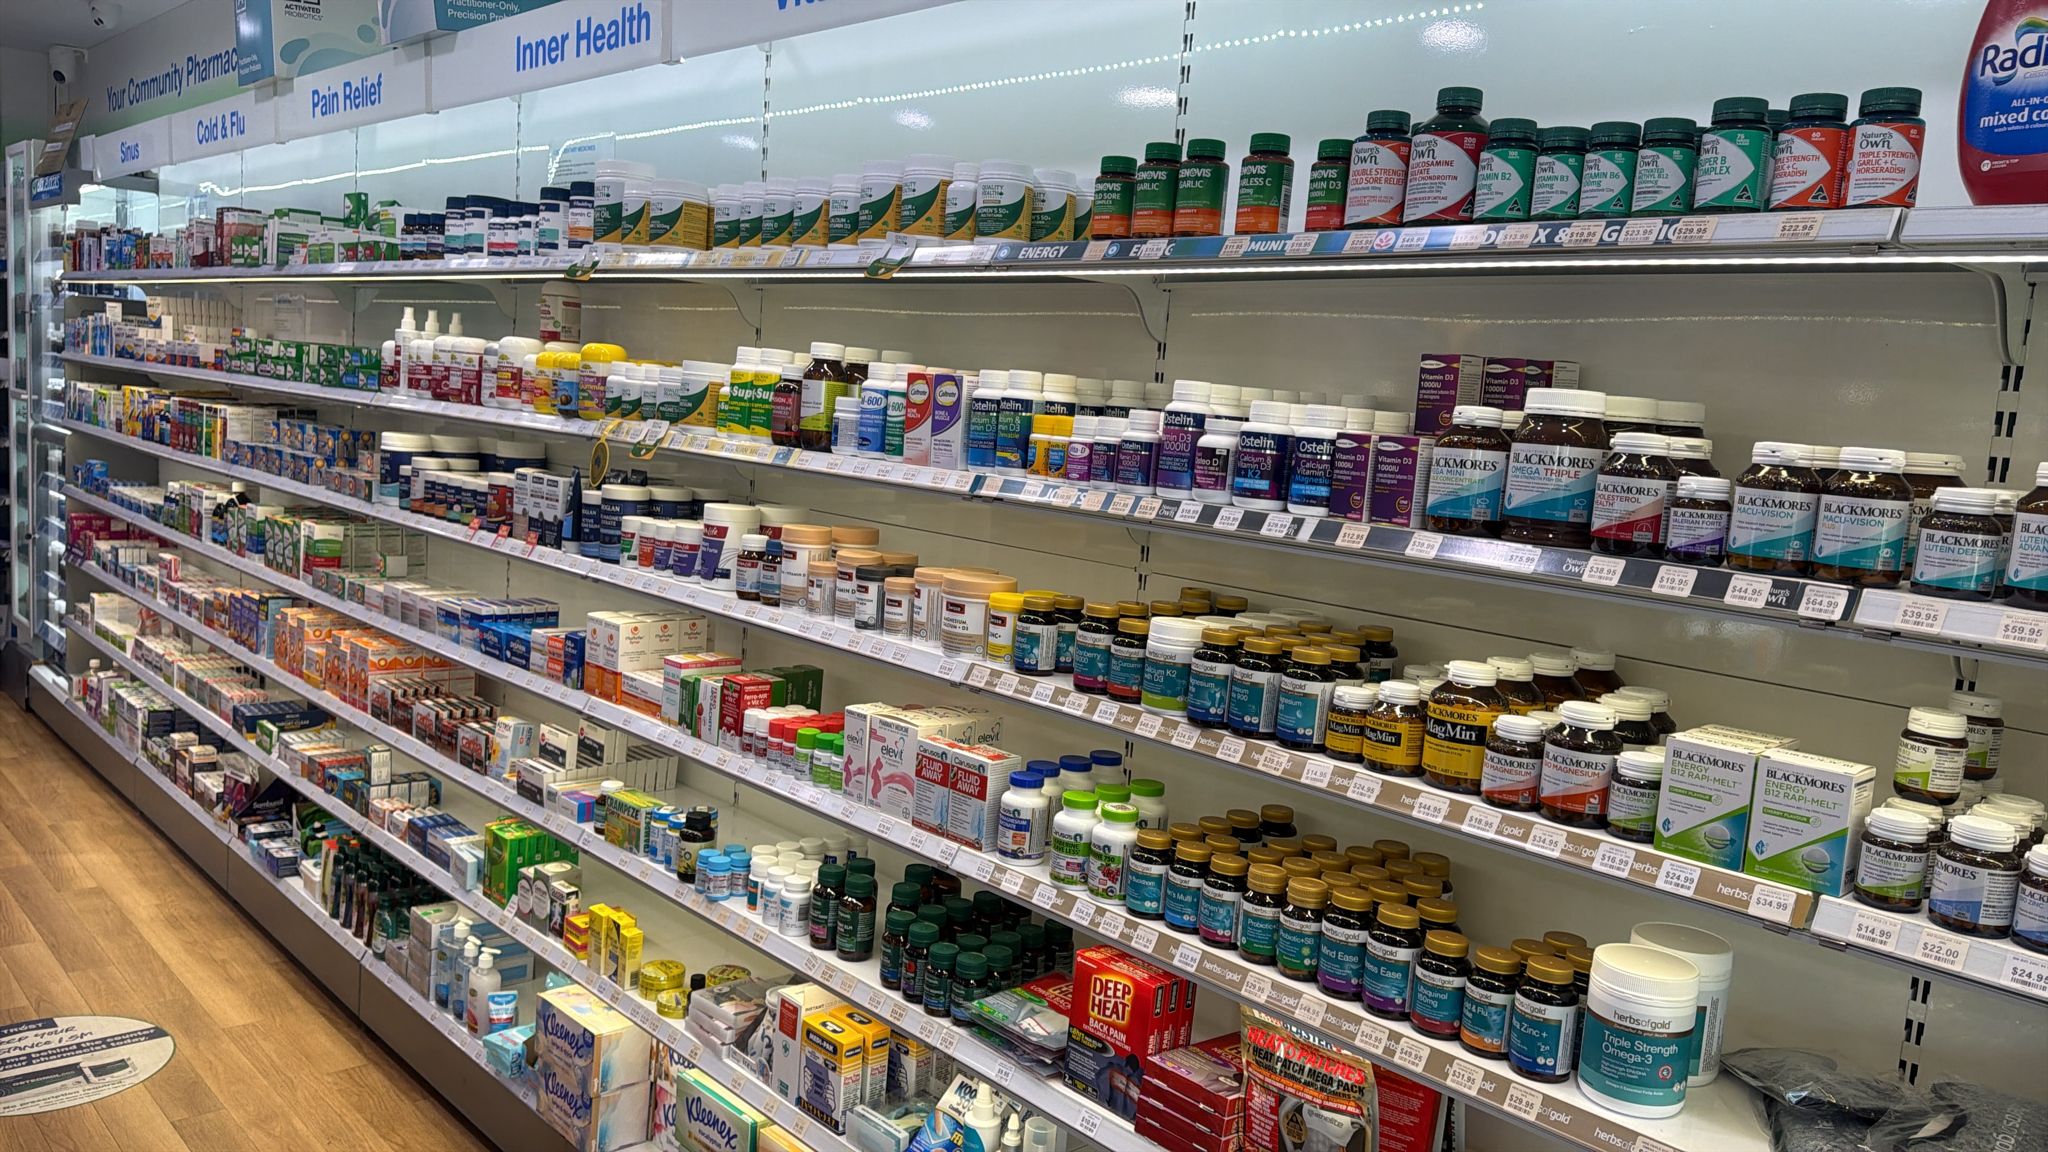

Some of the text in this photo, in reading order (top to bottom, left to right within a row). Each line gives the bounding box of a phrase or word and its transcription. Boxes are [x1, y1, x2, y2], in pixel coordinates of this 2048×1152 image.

[285, 4, 321, 14] ACTIVATED
[448, 9, 487, 20] Precision
[516, 2, 651, 72] Inner Health
[1980, 35, 2048, 77] Radi
[107, 47, 239, 112] Your Community Pharmac
[311, 73, 383, 119] Pain Relief
[1980, 106, 2048, 129] mixed co
[197, 110, 246, 145] Cold & Flu
[1413, 138, 1438, 148] Nature's
[1861, 131, 1894, 141] Nature's
[1859, 138, 1891, 150] Own
[120, 141, 140, 164] Sinus
[1353, 152, 1379, 165] Own
[1412, 145, 1437, 160] Own
[1858, 151, 1916, 160] TRIPLE STRENGTH
[1857, 159, 1882, 167] GARLIC
[1351, 168, 1373, 178] DOUBLE
[1501, 172, 1511, 180] B2
[1856, 166, 1906, 175] HORSERADISH
[1179, 180, 1203, 189] GARLIC
[1329, 181, 1342, 190] D3
[1364, 176, 1383, 185] SORE
[1569, 231, 1597, 239] $19.95
[1677, 227, 1708, 235] $29.95
[1781, 224, 1815, 233] $22.95
[1018, 245, 1069, 260] ENERGY
[1421, 373, 1454, 382] Vitamin D3
[1485, 377, 1508, 386] Vitamin
[1179, 433, 1192, 443] D3
[1239, 453, 1266, 464] Calcium
[1335, 452, 1355, 461] Vitamin
[1378, 456, 1413, 466] Vitamin D3
[1512, 450, 1596, 470] BLACKMORES
[1297, 467, 1323, 477] Vitamin
[1300, 460, 1331, 470] Calcium
[1248, 469, 1261, 479] K2
[1445, 467, 1465, 478] MINI
[1511, 465, 1580, 480] OMEGA TRIPLE
[1738, 495, 1812, 511] BLACKMORES
[1672, 510, 1724, 521] BLACKMORES
[1736, 507, 1795, 520] MACU-VISION
[1824, 502, 1903, 520] BLACKMORES
[1823, 514, 1885, 528] MACU-VISION
[1925, 532, 2001, 550] BLACKMORES
[1924, 543, 1956, 554] LUTEIN
[1659, 575, 1689, 587] $19.95
[1731, 585, 1763, 598] $44.95
[1805, 596, 1839, 610] $64.99
[1901, 608, 1938, 622] $39.95
[2003, 623, 2043, 638] $59.95
[1153, 674, 1164, 683] D3
[1166, 670, 1177, 678] K2
[1329, 721, 1361, 735] MagMin
[1426, 717, 1477, 741] MagMin
[881, 737, 905, 761] elevit
[919, 745, 940, 759] Carusos
[922, 759, 943, 772] FLUID
[954, 756, 978, 771] Carusos
[1671, 759, 1709, 775] ENERGY
[1673, 749, 1744, 773] BLACKMORES
[921, 769, 943, 782] AWAY
[957, 770, 980, 785] FLUID
[1489, 763, 1532, 778] MAGNESIUM
[1552, 763, 1600, 779] MAGNESIUM
[1670, 767, 1738, 789] B12 RAPI-MELT
[1766, 769, 1845, 794] BLACKMORES
[956, 781, 981, 797] AWAY
[1353, 782, 1376, 794] $24.95
[1765, 780, 1808, 795] ENERGY
[1764, 788, 1839, 811] B12 RAPI-MELT
[1418, 801, 1442, 815] $44.95
[1469, 815, 1494, 829] $18.95
[1532, 834, 1559, 848] $34.95
[1601, 854, 1629, 868] $16.99
[1865, 845, 1924, 864] BLACKMORES
[1664, 869, 1695, 886] $24.99
[1756, 894, 1789, 912] $34.99
[1857, 923, 1892, 940] $14.99
[1338, 950, 1359, 963] Ease
[1922, 942, 1960, 960] $22.00
[1202, 959, 1242, 983] herbsofgold
[1380, 966, 1402, 980] Ease
[1092, 976, 1133, 1000] DEEP
[1090, 995, 1130, 1022] HEAT
[1613, 1010, 1672, 1030] herbsofgold
[542, 1013, 584, 1058] Kleenex
[1088, 1018, 1108, 1035] BACK
[1109, 1027, 1127, 1043] PAIN
[1521, 1024, 1541, 1039] Zinc
[31, 1028, 156, 1057] behind the counter
[1360, 1031, 1383, 1045] $49.95
[1603, 1029, 1679, 1056] Triple Strength
[1399, 1048, 1423, 1062] $49.95
[1601, 1042, 1653, 1065] Omega-3
[1252, 1045, 1275, 1062] HEAT
[1276, 1055, 1305, 1076] PATCH
[1307, 1067, 1334, 1088] MEGA
[1336, 1079, 1366, 1097] PACK
[543, 1071, 583, 1119] Kleenex
[1509, 1094, 1535, 1110] $29.95
[685, 1096, 738, 1150] Kleenex
